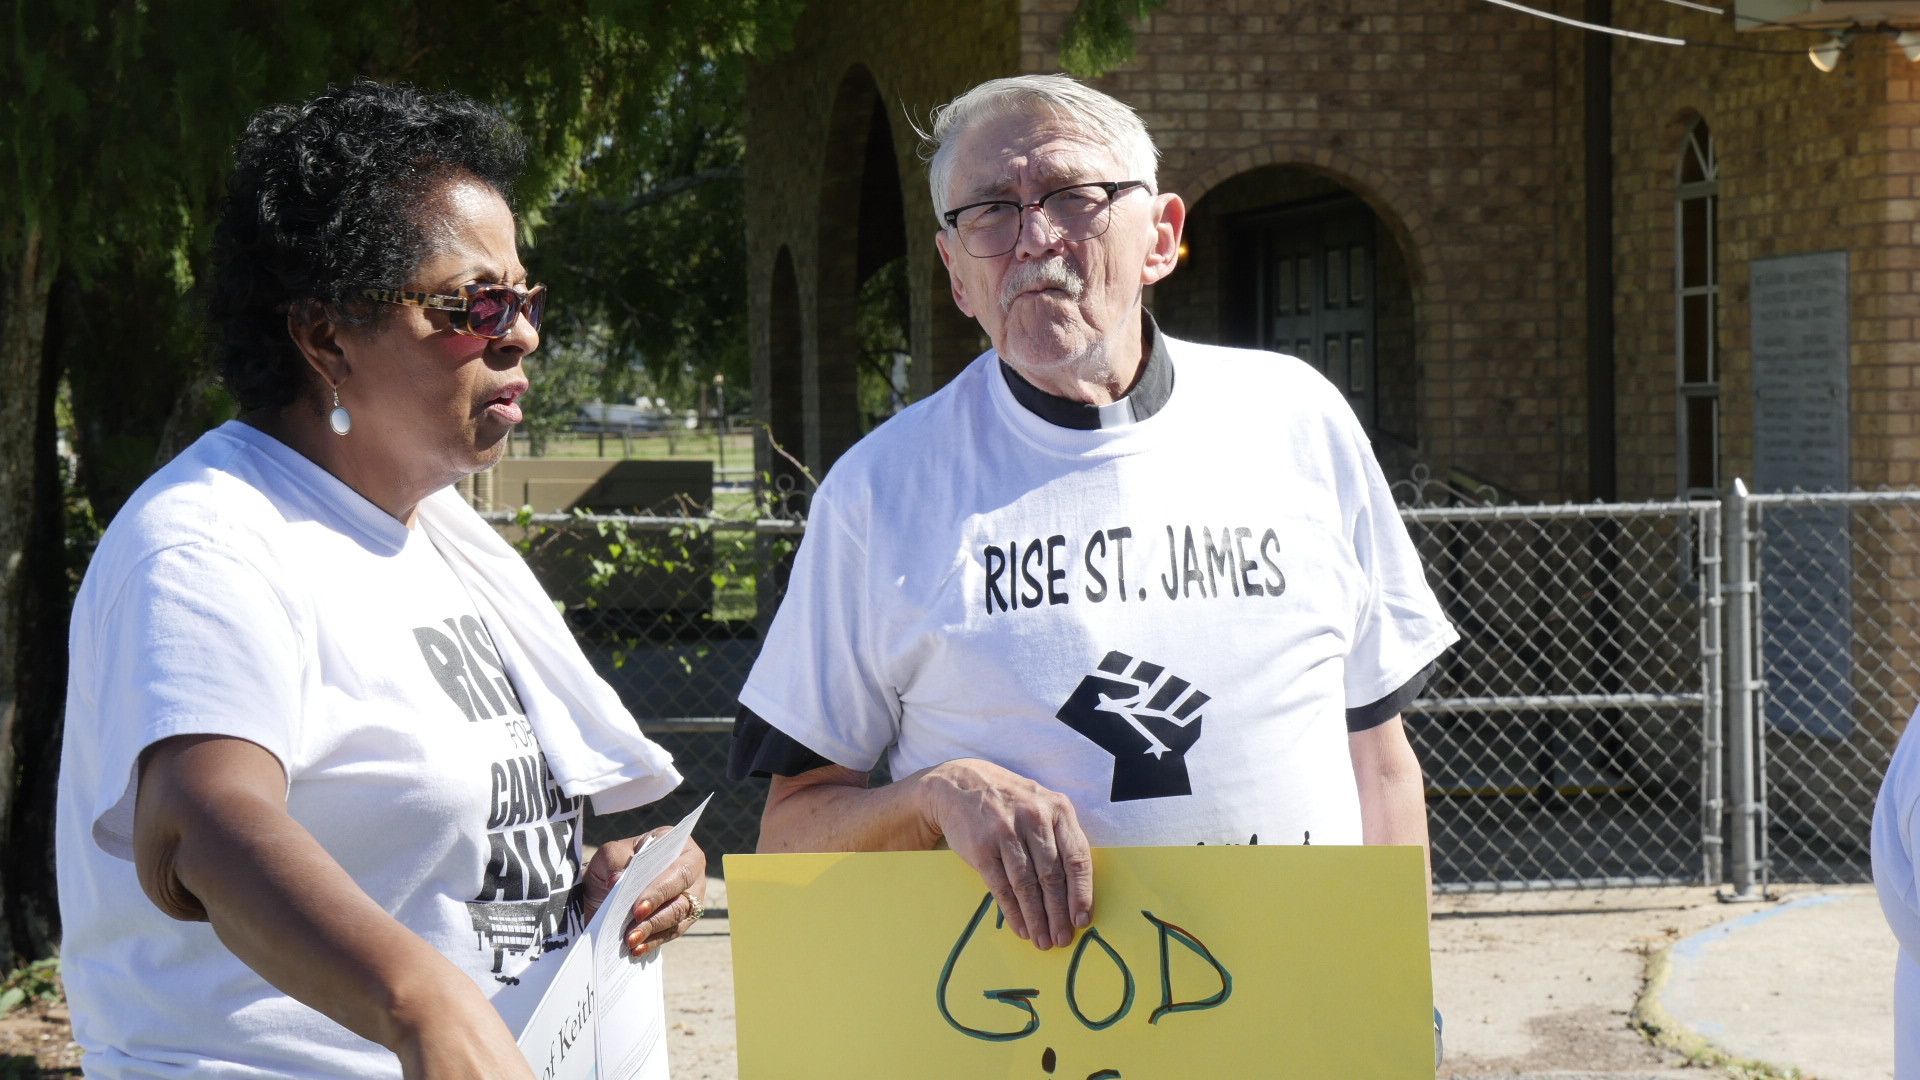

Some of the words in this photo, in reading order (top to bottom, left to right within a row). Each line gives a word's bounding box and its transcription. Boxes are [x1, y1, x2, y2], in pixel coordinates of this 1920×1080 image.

[984, 534, 1069, 615] RISE
[1084, 526, 1147, 603] ST.
[1161, 524, 1286, 601] JAMES
[412, 614, 527, 722] RIS
[487, 751, 581, 829] CANC
[474, 815, 580, 901] ALLEY
[936, 891, 1233, 1042] GOD
[558, 981, 595, 1063] Keith
